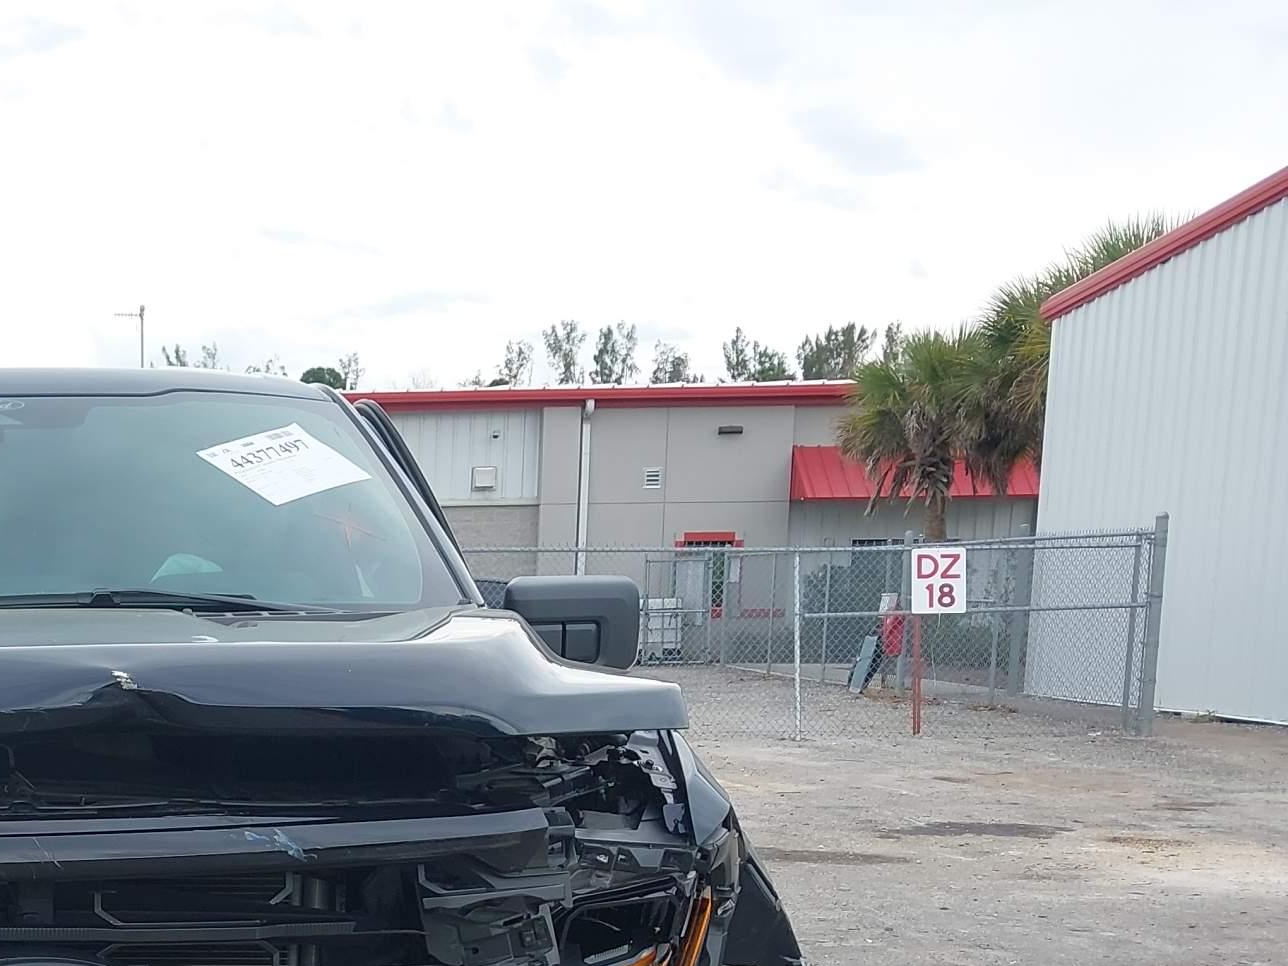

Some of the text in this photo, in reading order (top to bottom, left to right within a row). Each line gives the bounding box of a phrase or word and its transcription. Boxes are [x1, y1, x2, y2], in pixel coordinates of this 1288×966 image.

[230, 439, 310, 469] 44377497
[917, 553, 960, 579] DZ
[925, 583, 956, 608] 18
